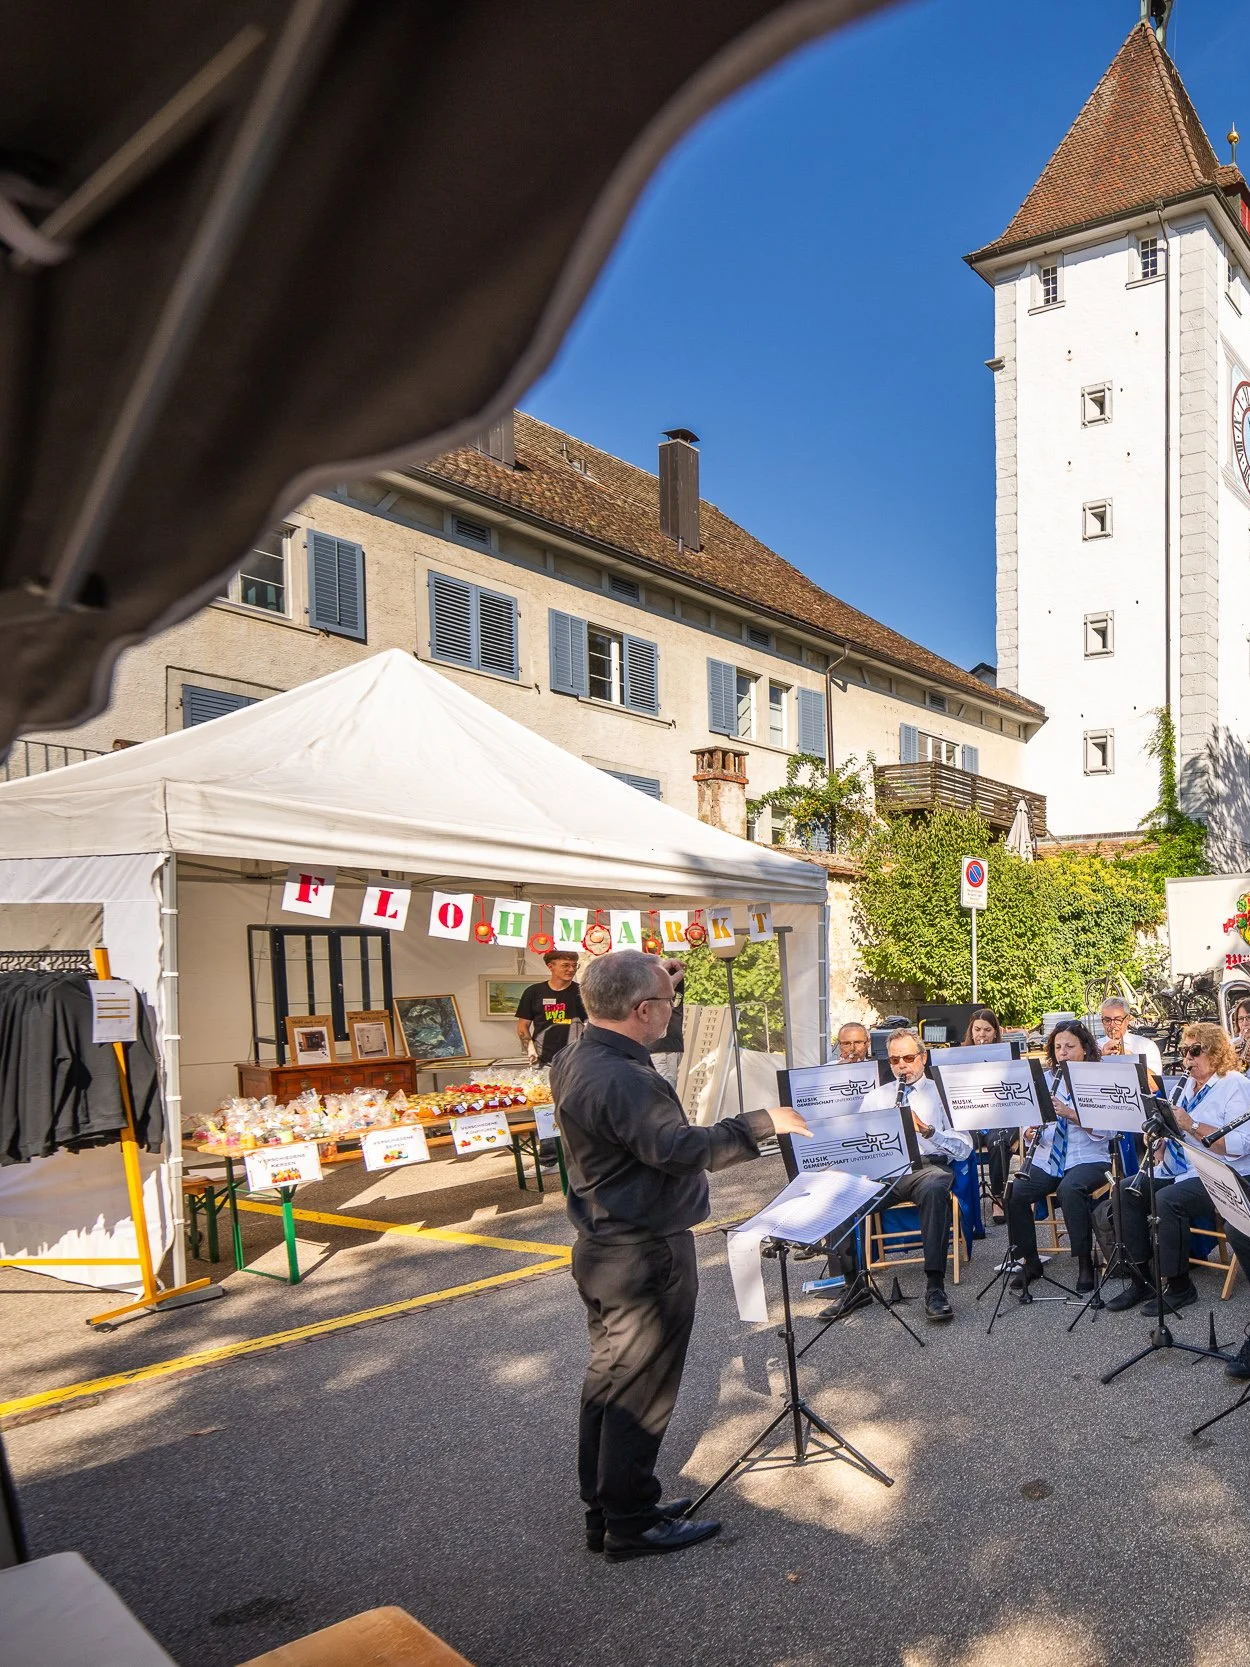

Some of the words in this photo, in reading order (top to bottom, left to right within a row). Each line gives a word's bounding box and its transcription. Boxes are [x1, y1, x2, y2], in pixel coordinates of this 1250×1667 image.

[796, 1096, 818, 1104] MUSIK
[797, 1099, 834, 1108] GEMEINSCHAFT
[952, 1103, 989, 1111] GEMEINSCHAFT
[802, 1155, 829, 1164] MUSIK
[803, 1158, 849, 1169] GEMEINSCHAFT
[850, 1151, 894, 1163] UNTERKLETTGAU
